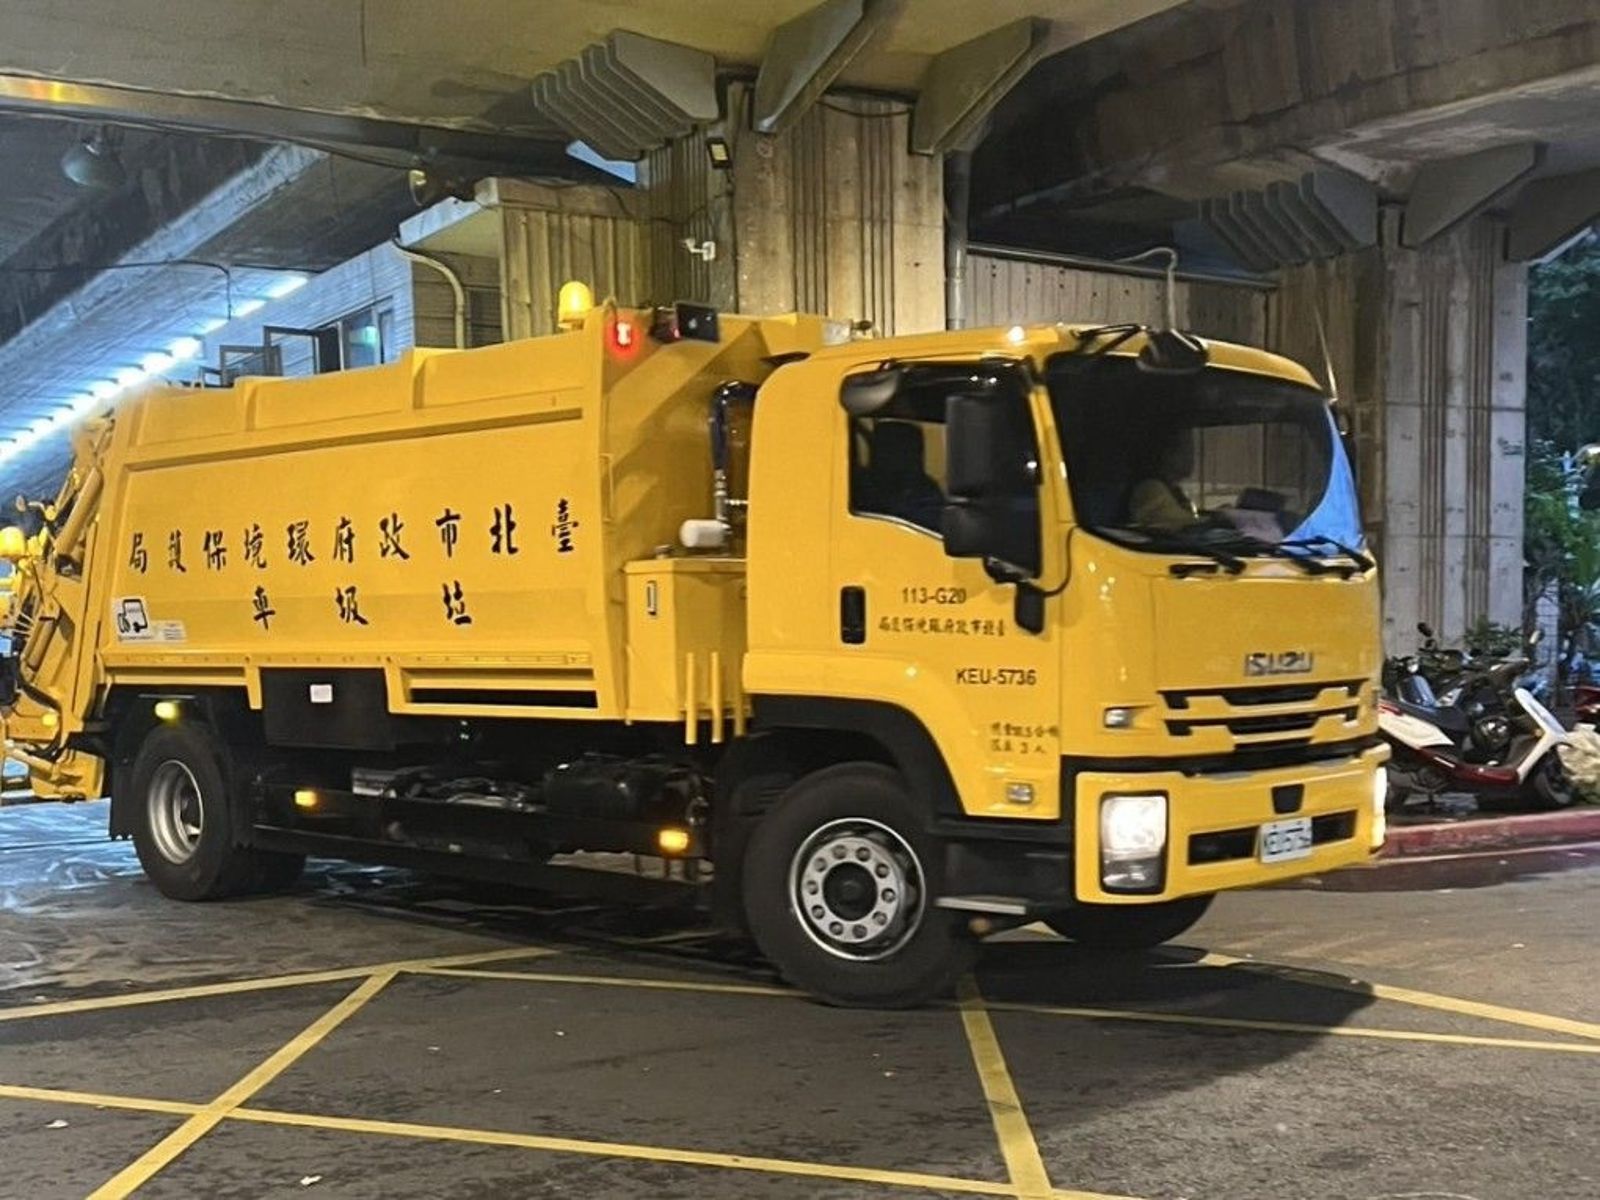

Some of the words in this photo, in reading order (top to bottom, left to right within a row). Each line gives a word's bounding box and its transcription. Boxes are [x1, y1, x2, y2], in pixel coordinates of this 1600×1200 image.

[252, 580, 472, 630] 垃圾車
[902, 587, 967, 605] 113-G20
[956, 669, 1037, 685] KEU-5736
